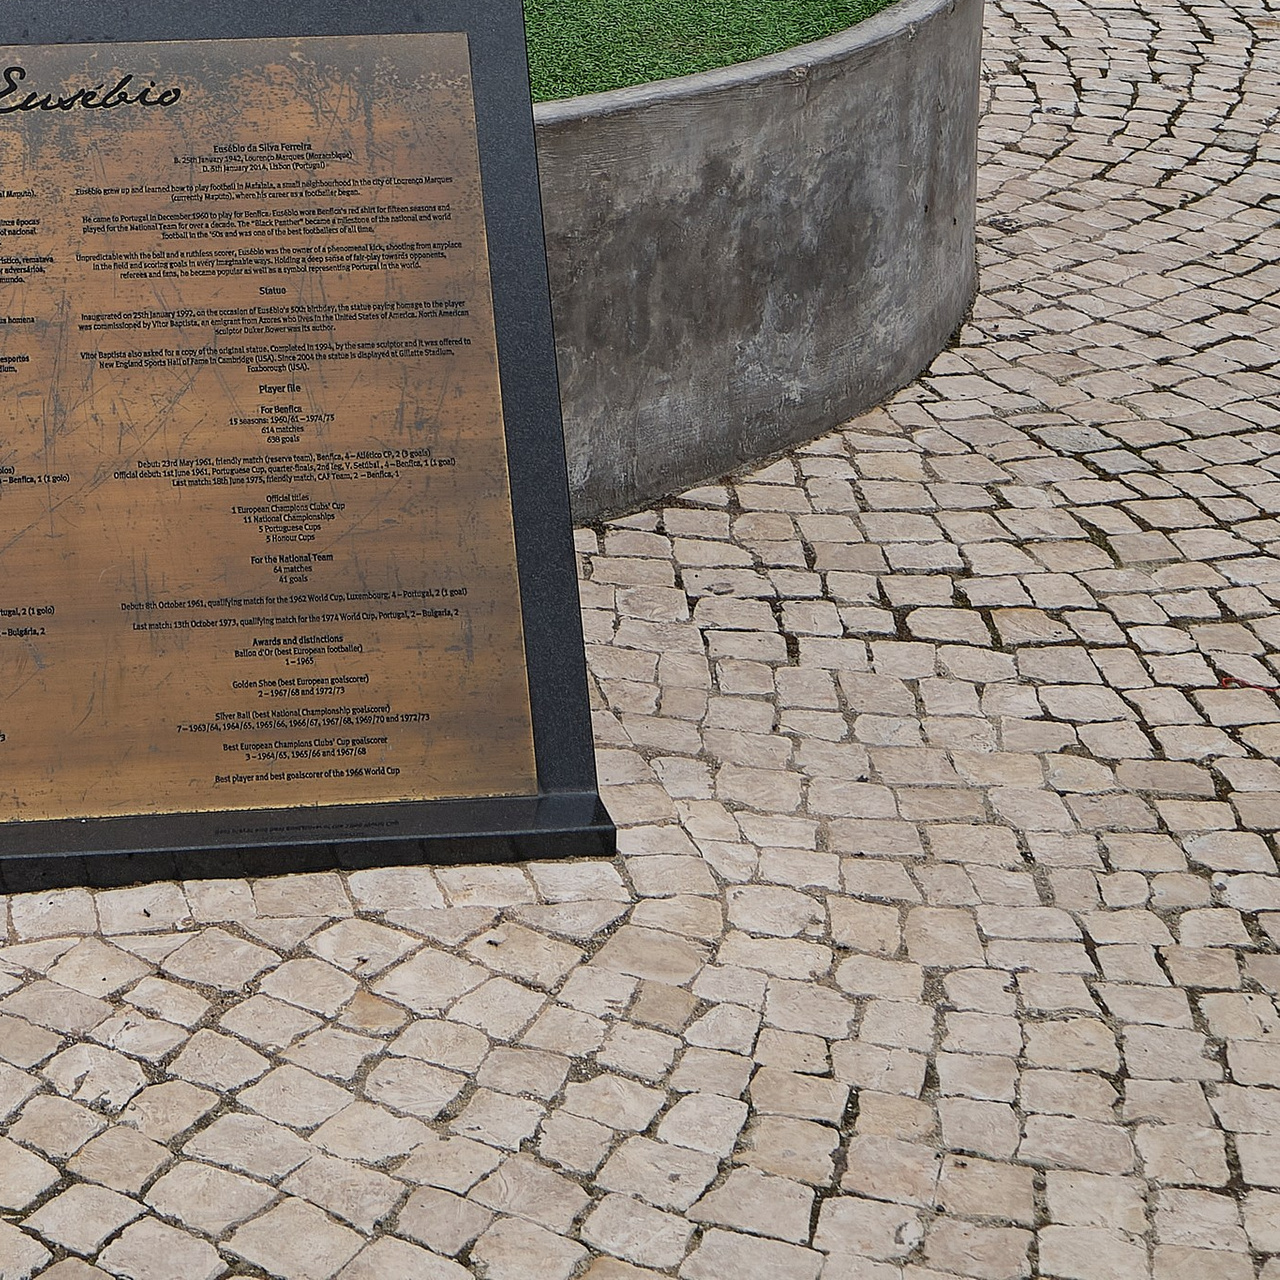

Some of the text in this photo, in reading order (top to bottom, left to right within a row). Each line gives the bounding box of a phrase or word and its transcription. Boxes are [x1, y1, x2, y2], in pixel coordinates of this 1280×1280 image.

[246, 144, 257, 152] da
[280, 143, 312, 151] Ferreira
[258, 286, 287, 294] Statue
[258, 384, 301, 394] Player file
[260, 405, 302, 414] For Benfica
[280, 435, 300, 444] goals
[265, 493, 309, 502] Official titles
[236, 505, 270, 515] European
[270, 503, 309, 513] Champions
[331, 502, 346, 511] Cup
[243, 512, 335, 523] 11 National Championships
[264, 523, 303, 533] Portuguese
[303, 523, 322, 532] Cups
[271, 534, 297, 542] Honour
[297, 533, 315, 542] Cups
[250, 553, 333, 564] For the National Team
[272, 564, 312, 573] 64 matches
[288, 574, 308, 583] goals
[251, 634, 343, 646] Awards and distinctions
[234, 649, 257, 657] Ballon
[273, 647, 292, 657] (best
[292, 646, 326, 656] European
[326, 644, 363, 654] footballer)
[232, 675, 369, 688] Golden Shoe (best European goalscorer)
[222, 743, 239, 751] Best
[239, 741, 273, 751] European
[273, 739, 313, 750] Champions
[336, 737, 351, 747] Cup
[350, 736, 388, 746] goalscorer
[214, 775, 231, 783] Best
[231, 773, 255, 783] player
[254, 773, 269, 781] and
[269, 772, 285, 780] best
[285, 770, 324, 781] goalscorer
[331, 769, 345, 777] the
[345, 768, 364, 776] 1966
[363, 767, 386, 775] World
[385, 766, 401, 776] Cup
